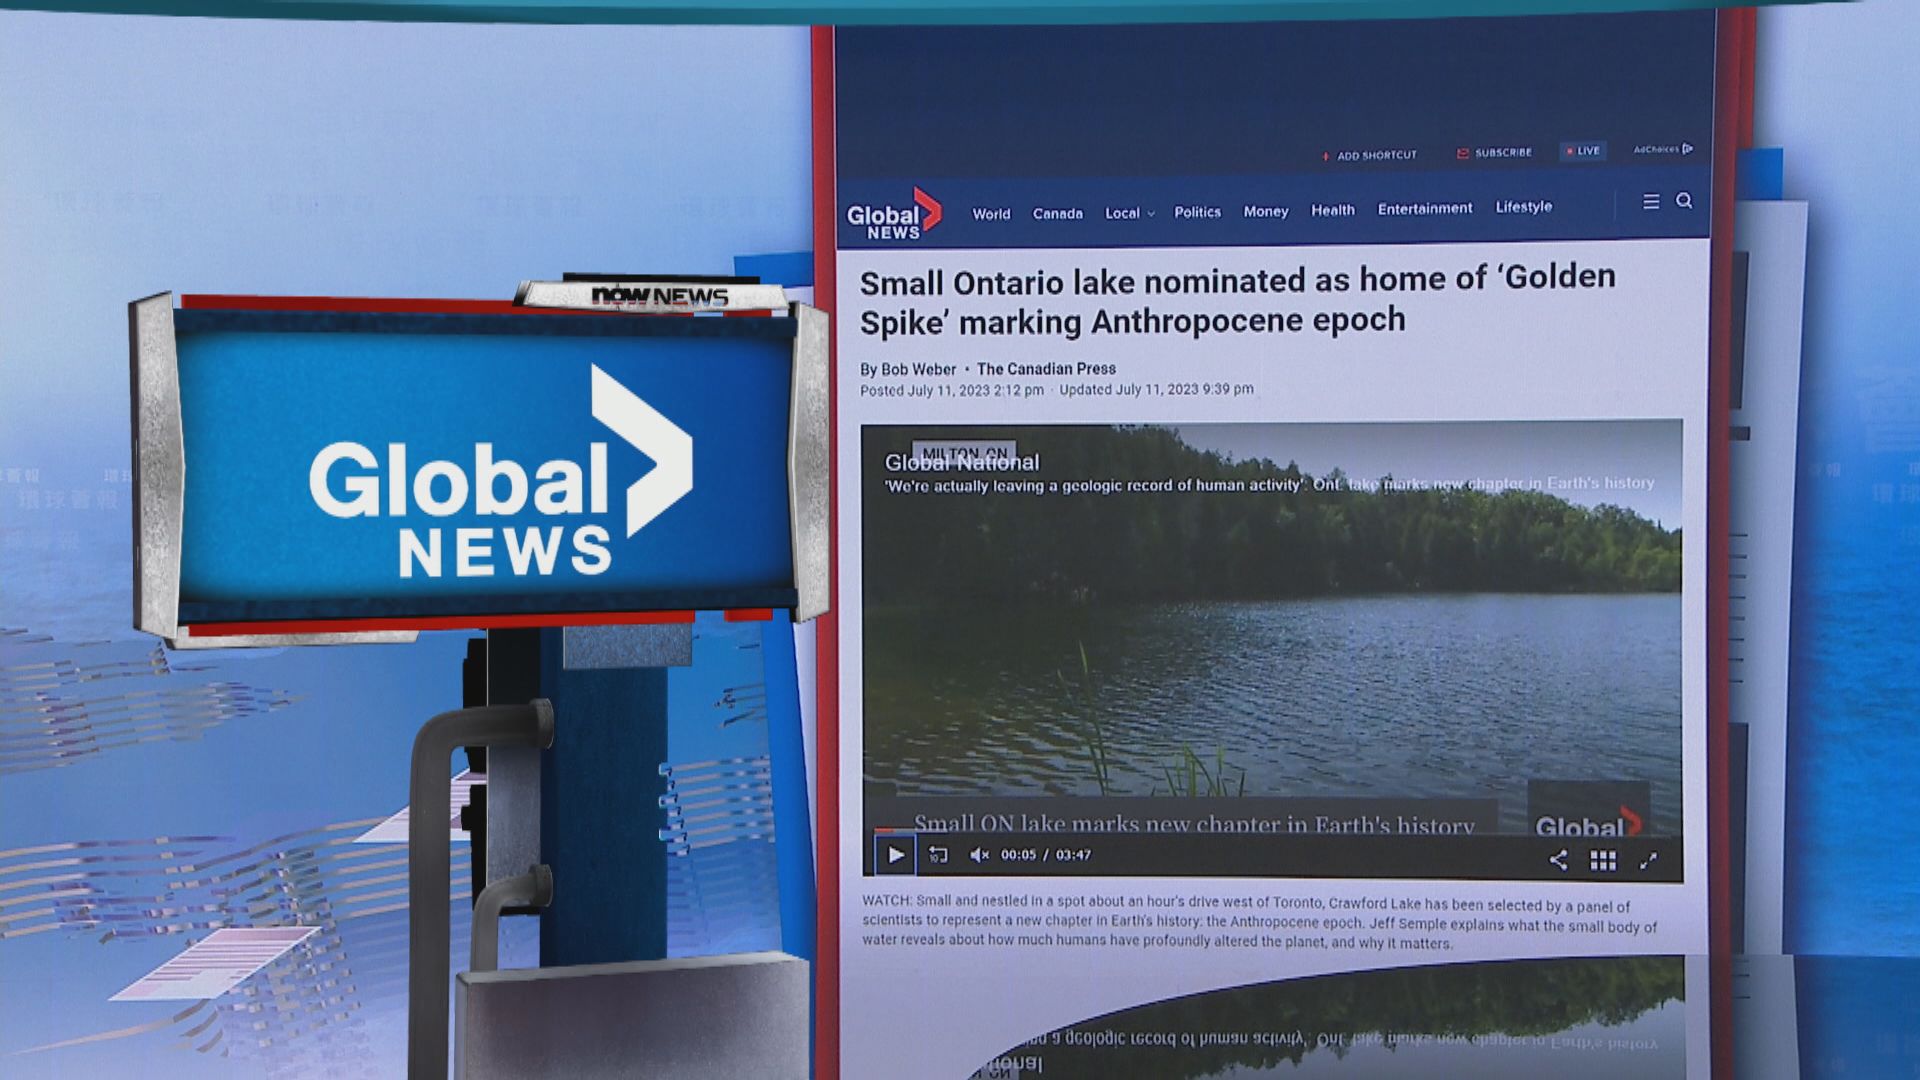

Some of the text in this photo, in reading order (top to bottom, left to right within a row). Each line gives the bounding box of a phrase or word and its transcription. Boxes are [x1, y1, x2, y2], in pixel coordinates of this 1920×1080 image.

[1338, 150, 1416, 161] ADD SHORTCUT
[1476, 148, 1531, 157] SUBSCRIBE
[1578, 146, 1599, 155] LIVE
[848, 205, 919, 226] Global
[973, 200, 1552, 220] World Canada Local Politics Money Health Entertainment Lifestyle
[867, 225, 920, 240] NEWS
[861, 269, 942, 296] Small
[955, 270, 1063, 296] Ontario
[1075, 268, 1134, 295] lake
[1146, 266, 1304, 294] nominated
[1316, 273, 1349, 293] as
[1361, 264, 1445, 292] home
[1457, 262, 1488, 290] of
[961, 308, 1080, 341] marking
[1091, 307, 1303, 339] Anthropocene
[1314, 304, 1405, 338] epoch
[861, 362, 1116, 378] By Bob Weber The Canadian Press
[861, 384, 904, 397] Posted
[908, 384, 933, 399] July
[960, 384, 990, 397] 2023
[994, 384, 1020, 397] 2:12
[1025, 386, 1044, 399] pm
[1060, 383, 1112, 398] Updated
[1116, 383, 1141, 399] July
[1168, 382, 1198, 395] 2023
[1203, 382, 1229, 395] 9:39
[1234, 384, 1254, 397] pm
[885, 453, 1040, 472] Global National
[309, 441, 608, 518] Global
[935, 479, 988, 495] actually
[994, 480, 1044, 495] leaving
[1050, 482, 1057, 492] a
[1063, 479, 1122, 495] geologic
[1128, 478, 1172, 492] record
[1178, 478, 1191, 491] of
[1197, 478, 1244, 491] human
[1350, 478, 1379, 491] lake
[1385, 478, 1429, 491] marks
[1434, 480, 1464, 491] new
[1468, 477, 1523, 493] chapter
[1529, 478, 1542, 490] in
[1548, 476, 1599, 490] Earth's
[1605, 476, 1655, 491] history
[399, 525, 612, 578] NEWS
[914, 814, 1474, 833] Small ON lake marks new chapter in Earth's history
[1537, 817, 1623, 836] Global
[1002, 849, 1036, 860] 00:05
[1057, 850, 1091, 860] 03:47
[863, 894, 1630, 915] WATCH: Small and nestled in a spot about an hour's drive west of Toronto, Crawford Lake has been selected by a panel of
[863, 914, 922, 926] scientists
[927, 914, 939, 926] to
[943, 915, 1001, 928] represent
[1006, 916, 1012, 926] a
[1017, 916, 1041, 927] new
[1046, 914, 1092, 928] chapter
[1097, 915, 1107, 926] in
[1112, 914, 1152, 927] Earth's
[1207, 915, 1226, 928] the
[1231, 916, 1319, 930] Anthropocene
[1323, 916, 1365, 932] epoch.
[1370, 916, 1395, 929] Jeff
[1399, 918, 1447, 932] Semple
[1451, 918, 1504, 933] explains
[1508, 919, 1539, 931] what
[1544, 919, 1564, 933] the
[1569, 920, 1603, 933] small
[1608, 920, 1640, 936] body
[1644, 921, 1657, 933] of
[863, 932, 1453, 952] water reveals about how much humans have profoundly altered the planet, and why it matters.
